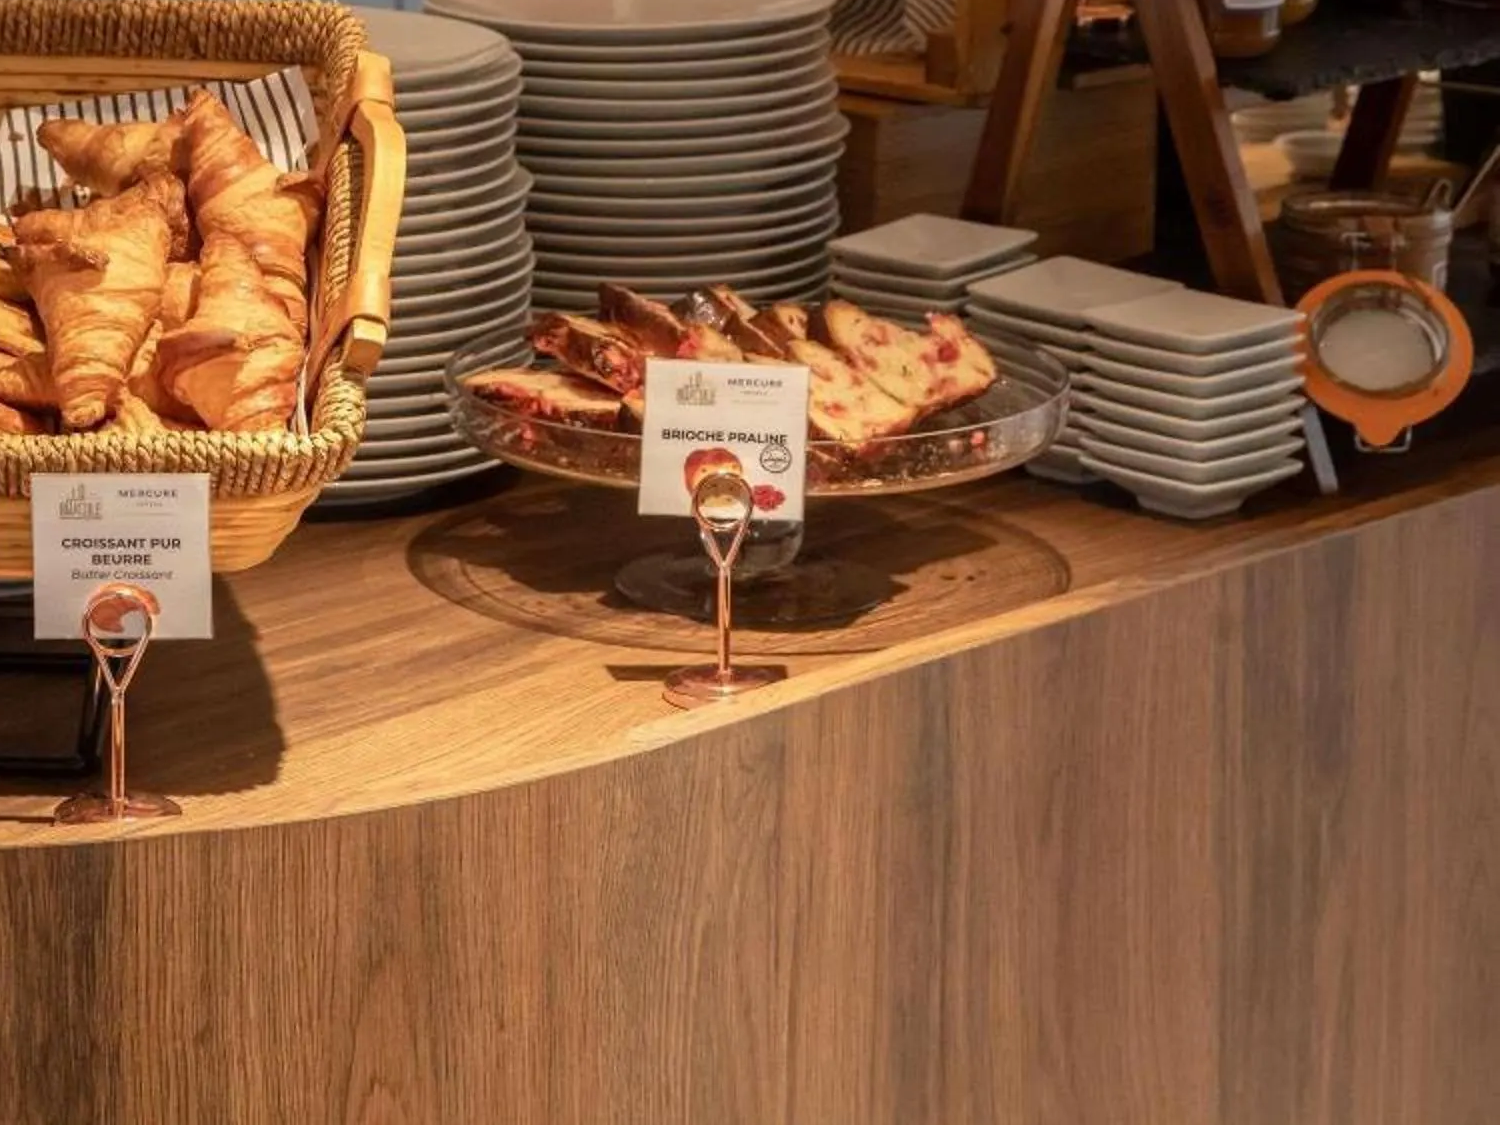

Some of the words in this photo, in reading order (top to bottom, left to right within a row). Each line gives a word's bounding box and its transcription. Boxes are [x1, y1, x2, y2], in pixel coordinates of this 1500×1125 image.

[728, 378, 783, 388] MERCURE
[662, 428, 725, 442] BRIOCHE
[728, 431, 788, 446] PRALINE
[118, 488, 178, 499] MERCURE
[61, 538, 146, 550] CROISSANT
[150, 538, 181, 550] PUR
[91, 554, 153, 566] BEURRE
[71, 570, 111, 580] Butter
[113, 570, 174, 580] Croissant
